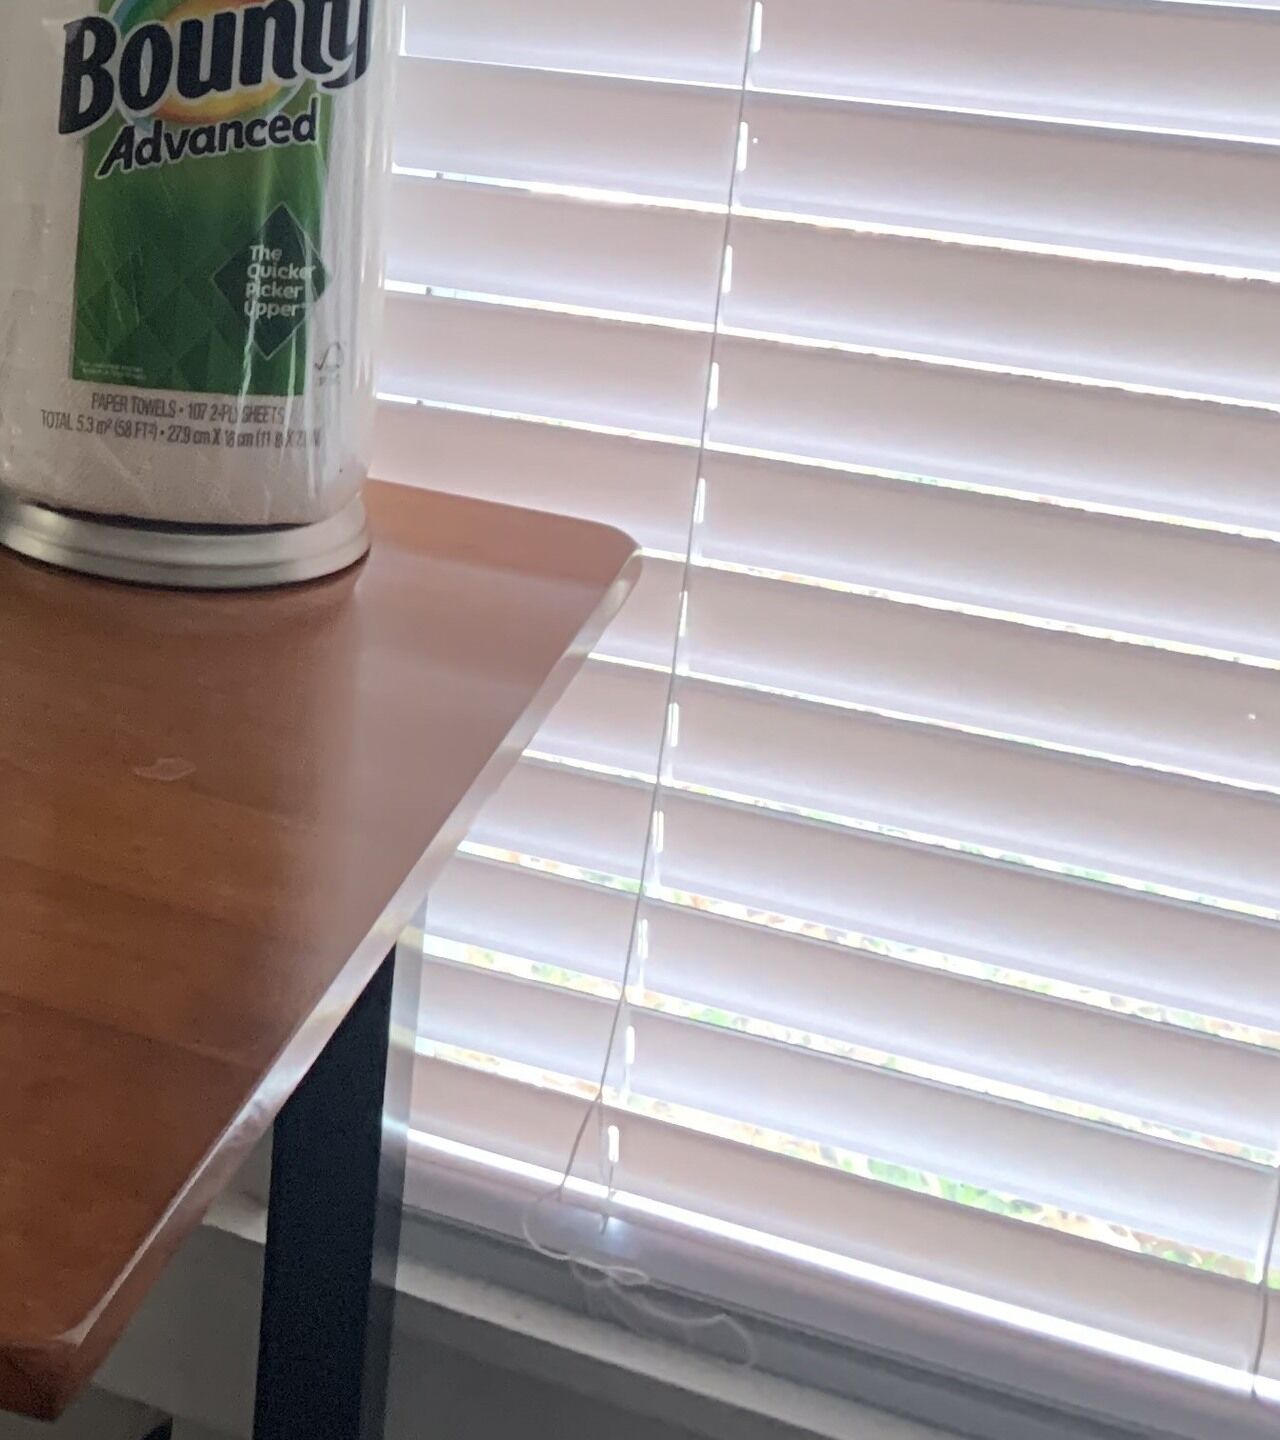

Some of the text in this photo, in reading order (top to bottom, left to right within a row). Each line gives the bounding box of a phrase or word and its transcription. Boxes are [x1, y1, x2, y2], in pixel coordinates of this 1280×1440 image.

[95, 96, 320, 178] Advanced
[249, 244, 283, 261] The
[246, 263, 316, 280] Quicker
[245, 281, 305, 300] Picker
[243, 300, 301, 320] Upper
[91, 392, 129, 413] PAPER
[131, 395, 177, 418] TOWELS
[188, 403, 208, 421] 107
[242, 405, 286, 425] SHEETS
[40, 409, 73, 431] TOTAL
[76, 414, 94, 433] 5.3
[193, 429, 210, 445] cm
[237, 431, 254, 448] cm
